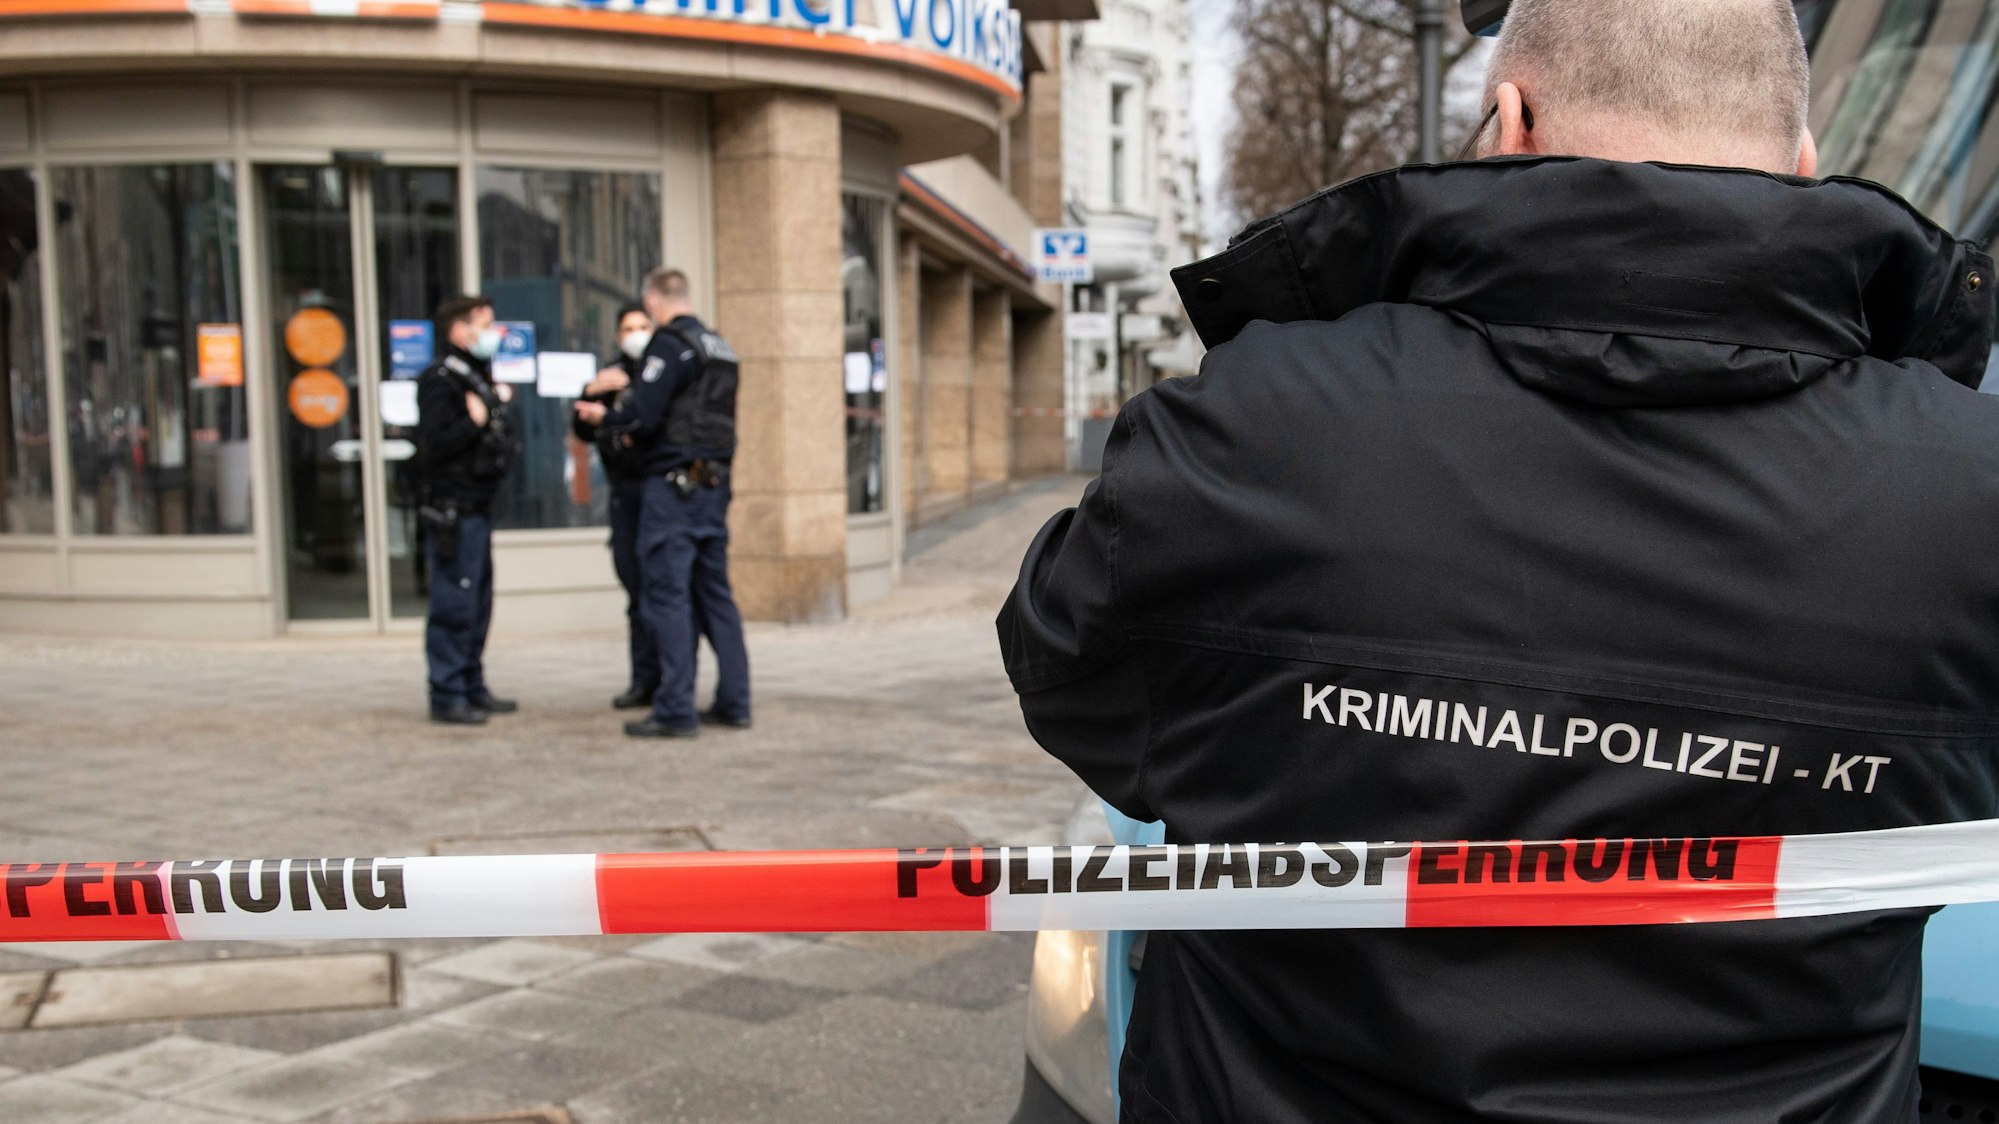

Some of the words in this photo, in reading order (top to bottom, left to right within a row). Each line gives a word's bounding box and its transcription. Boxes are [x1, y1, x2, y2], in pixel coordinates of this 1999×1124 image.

[1303, 682, 1780, 784] KRIMINALPOLIZEI
[1793, 769, 1810, 778] -
[1821, 753, 1891, 794] KT
[0, 857, 407, 918] PERRUNG
[897, 838, 1741, 898] POLIZEIABSPERRUNG
